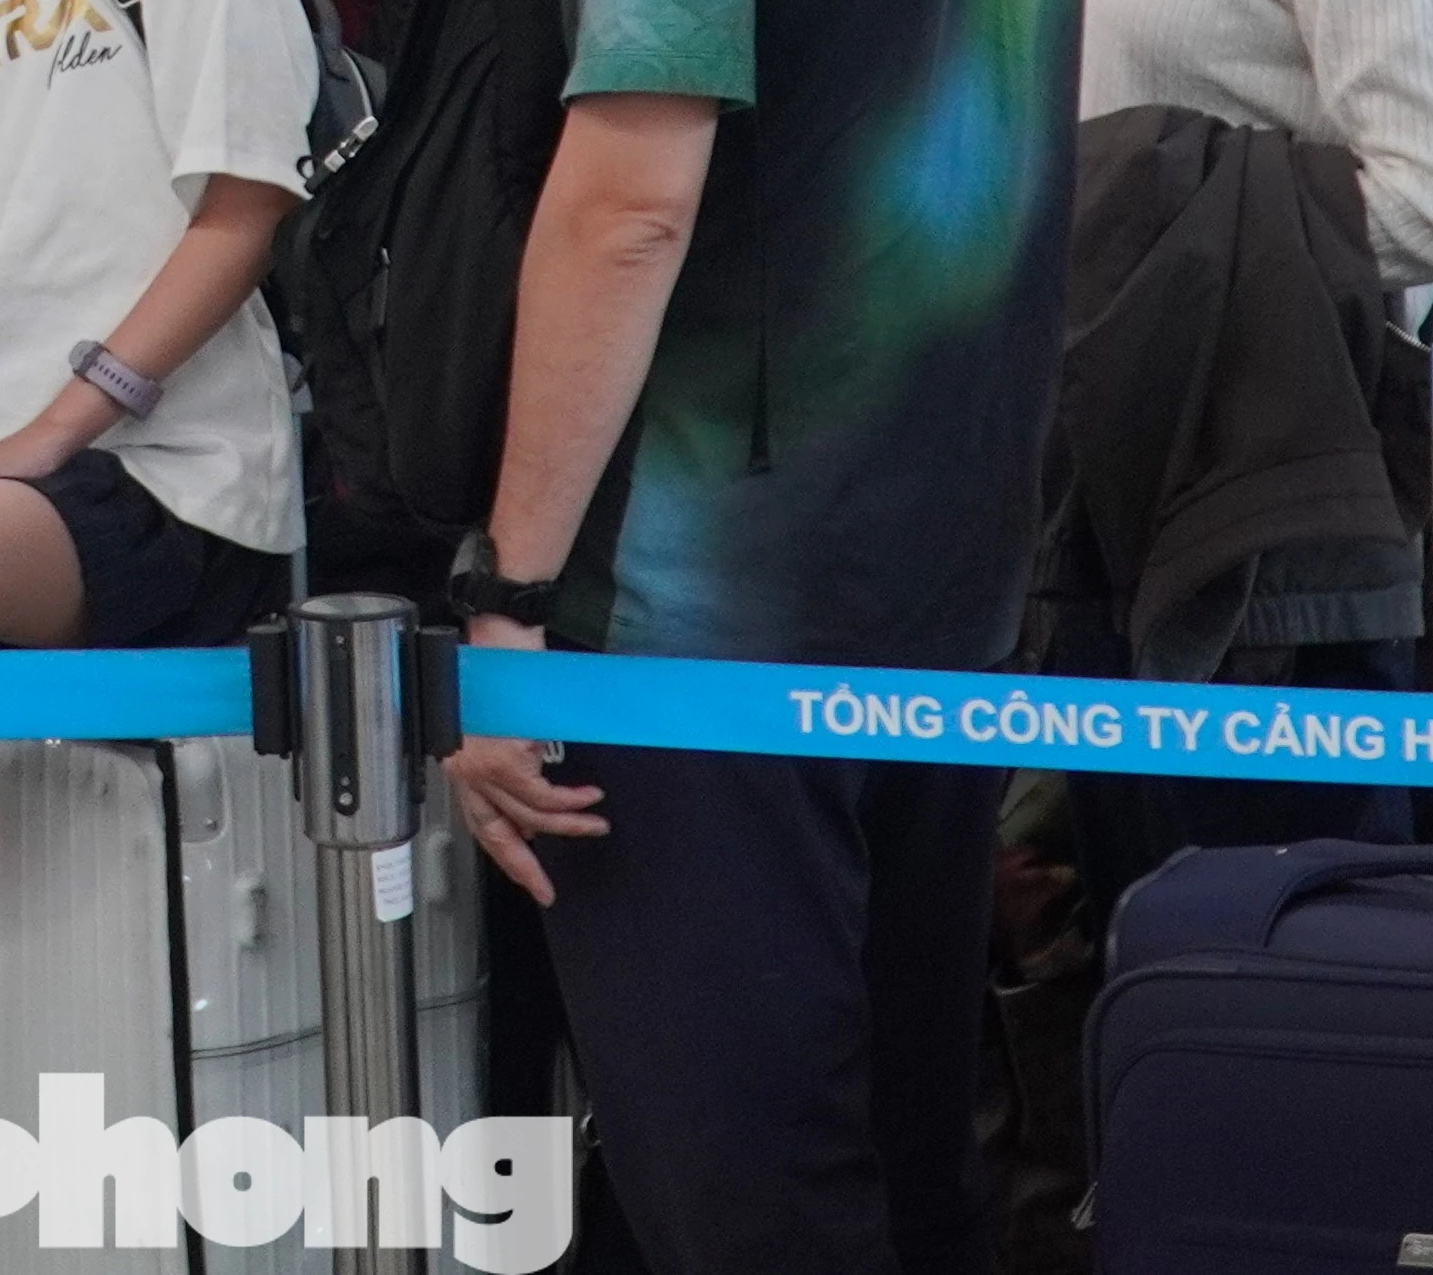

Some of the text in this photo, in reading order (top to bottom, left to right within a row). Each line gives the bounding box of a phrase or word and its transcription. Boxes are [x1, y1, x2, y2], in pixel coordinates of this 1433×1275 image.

[791, 682, 943, 741] TỔNG
[961, 691, 1122, 749] CÔNG
[1138, 707, 1208, 751] TY
[1223, 702, 1386, 761] CẢNG
